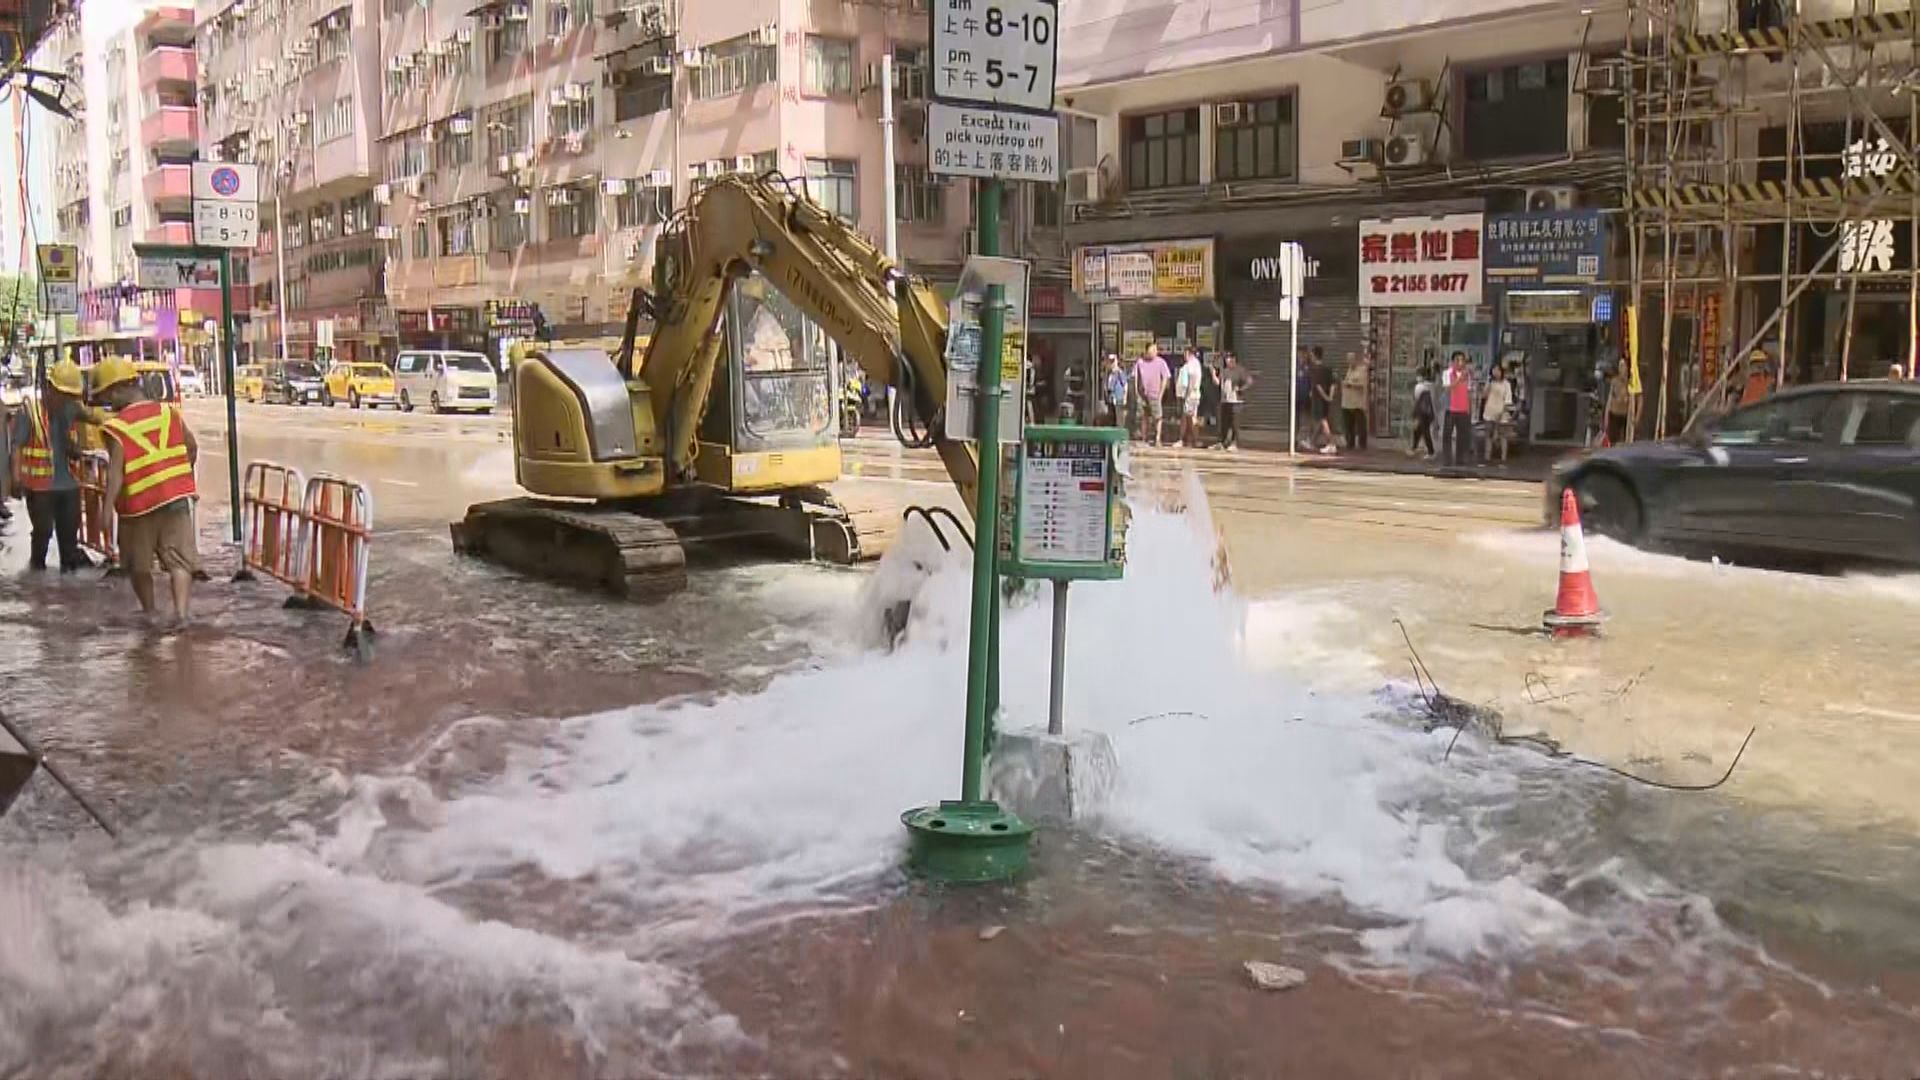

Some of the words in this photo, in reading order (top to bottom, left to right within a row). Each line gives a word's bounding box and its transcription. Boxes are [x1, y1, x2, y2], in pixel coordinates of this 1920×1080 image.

[942, 14, 979, 38] 上午
[985, 7, 1050, 45] 8-10
[948, 49, 971, 63] pm
[942, 67, 979, 89] 下午
[985, 59, 1039, 93] 5-7
[960, 114, 1005, 131] Except
[1008, 118, 1031, 131] taxi
[945, 130, 972, 144] pick
[1028, 135, 1044, 149] off
[934, 148, 1053, 175] 的士上落客除外
[219, 207, 255, 222] 8-10
[219, 228, 249, 242] 5-7
[1250, 257, 1281, 280] ONY
